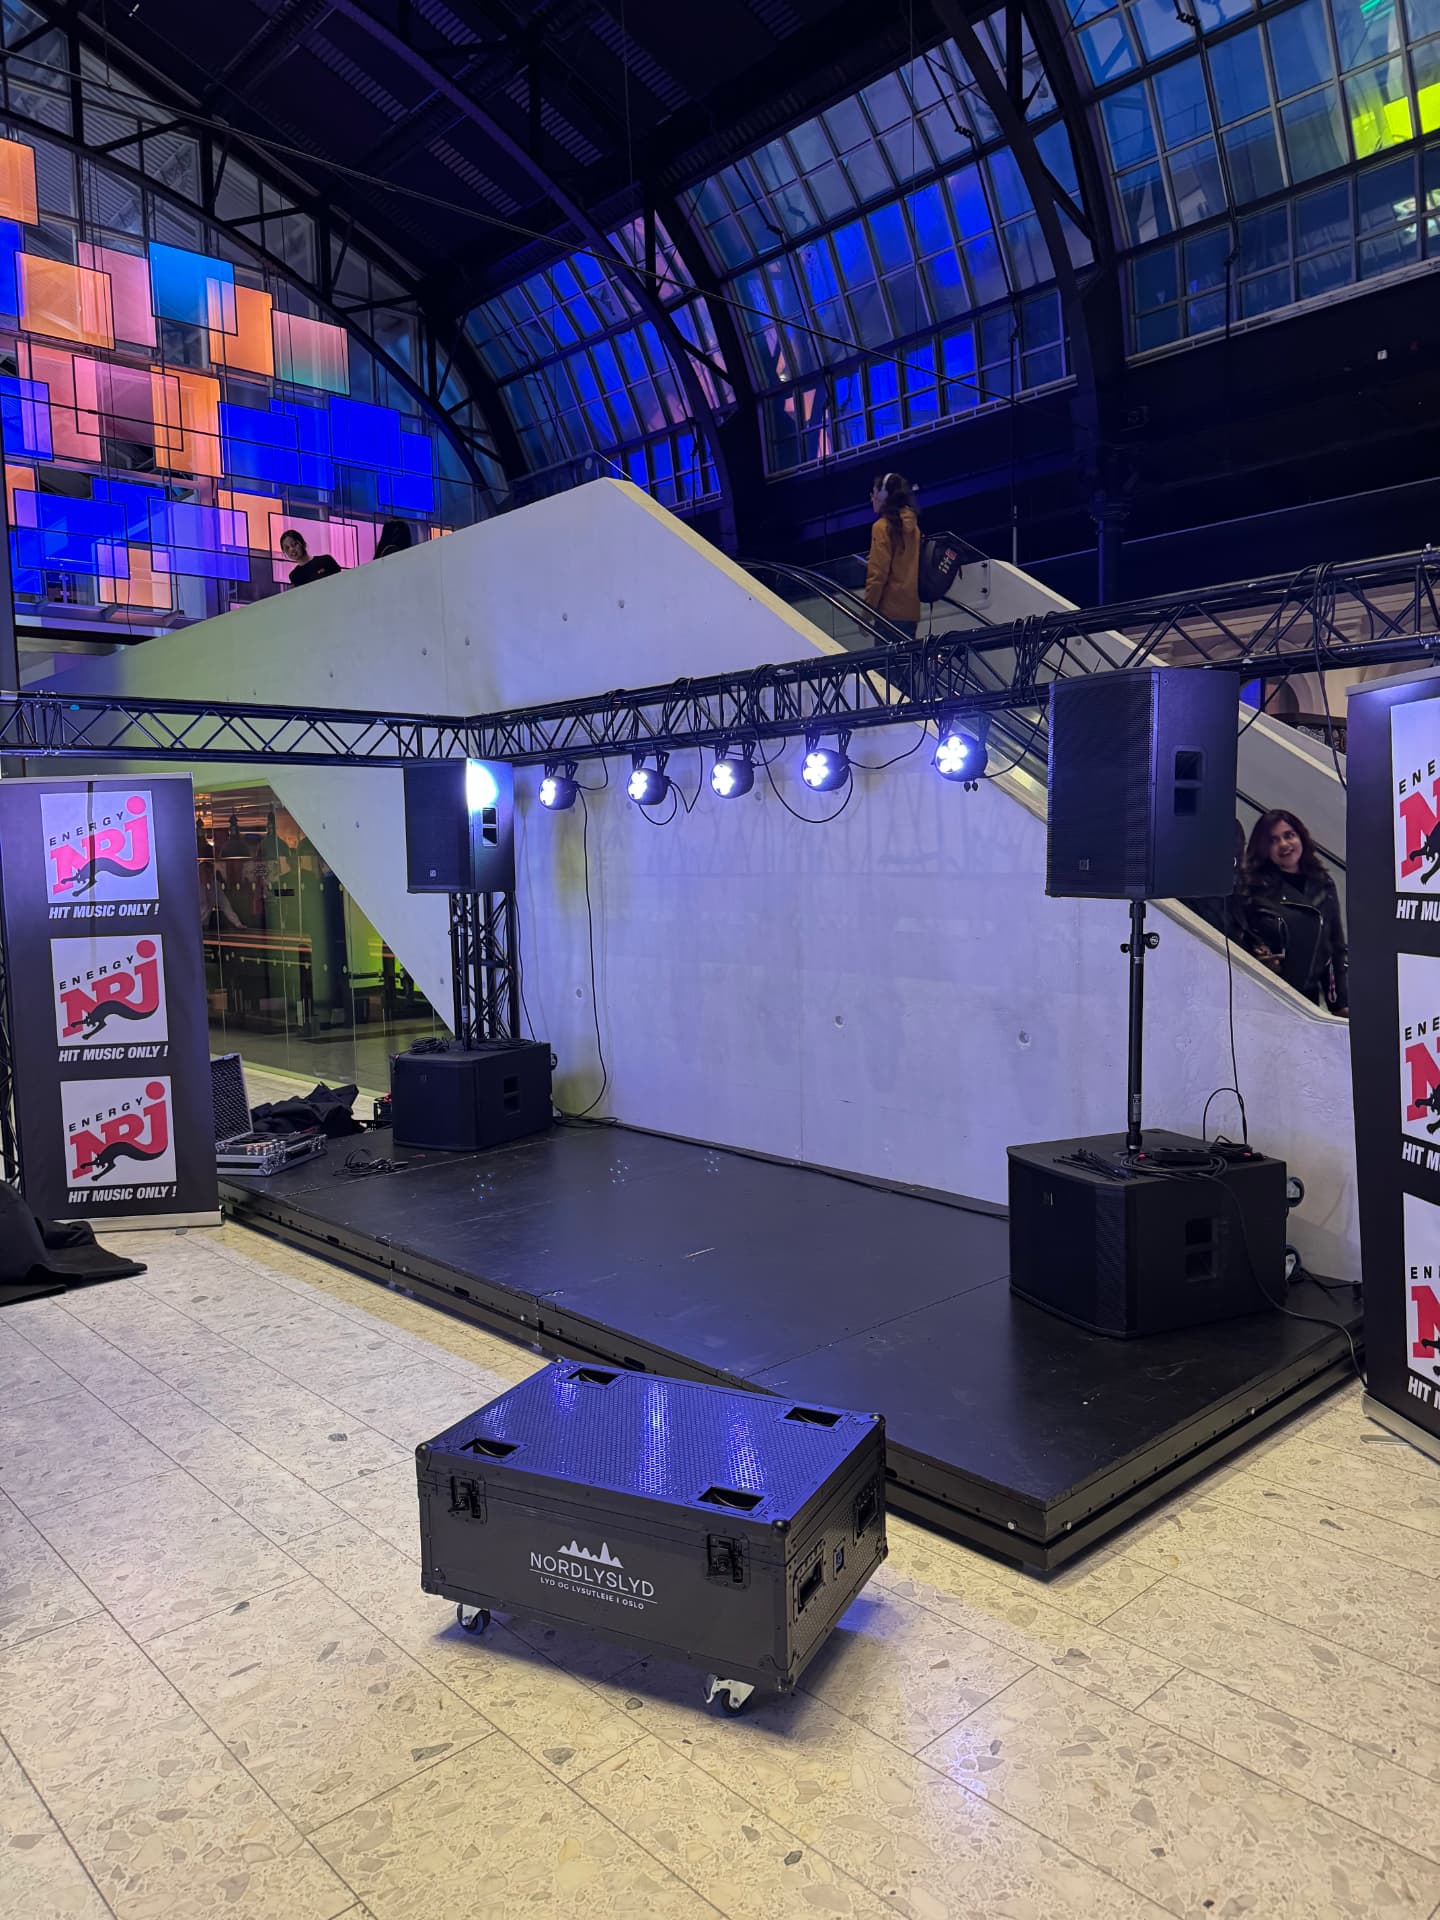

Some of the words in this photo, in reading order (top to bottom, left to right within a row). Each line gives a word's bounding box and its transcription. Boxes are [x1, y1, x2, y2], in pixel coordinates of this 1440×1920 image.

[1398, 760, 1436, 795] ENE
[49, 811, 124, 847] ENERGY
[48, 906, 71, 919] HIT
[72, 904, 116, 918] MUSIC
[118, 903, 151, 917] ONLY
[1396, 899, 1419, 920] HIT
[59, 955, 134, 990] ENERGY
[1404, 1016, 1440, 1041] ENE
[58, 1049, 81, 1062] HIT
[82, 1047, 125, 1061] MUSIC
[127, 1045, 160, 1059] ONLY
[68, 1097, 143, 1132] ENERGY
[1402, 1141, 1425, 1166] HIT
[68, 1190, 90, 1203] HIT
[92, 1188, 134, 1202] MUSIC
[136, 1186, 169, 1200] ONLY
[1407, 1375, 1431, 1403] HIT
[530, 1551, 655, 1597] NORDLYSLYD
[540, 1576, 556, 1586] LYD
[557, 1581, 570, 1590] OG
[571, 1585, 614, 1602] LYSUTLEIE
[622, 1599, 645, 1610] OSLO
